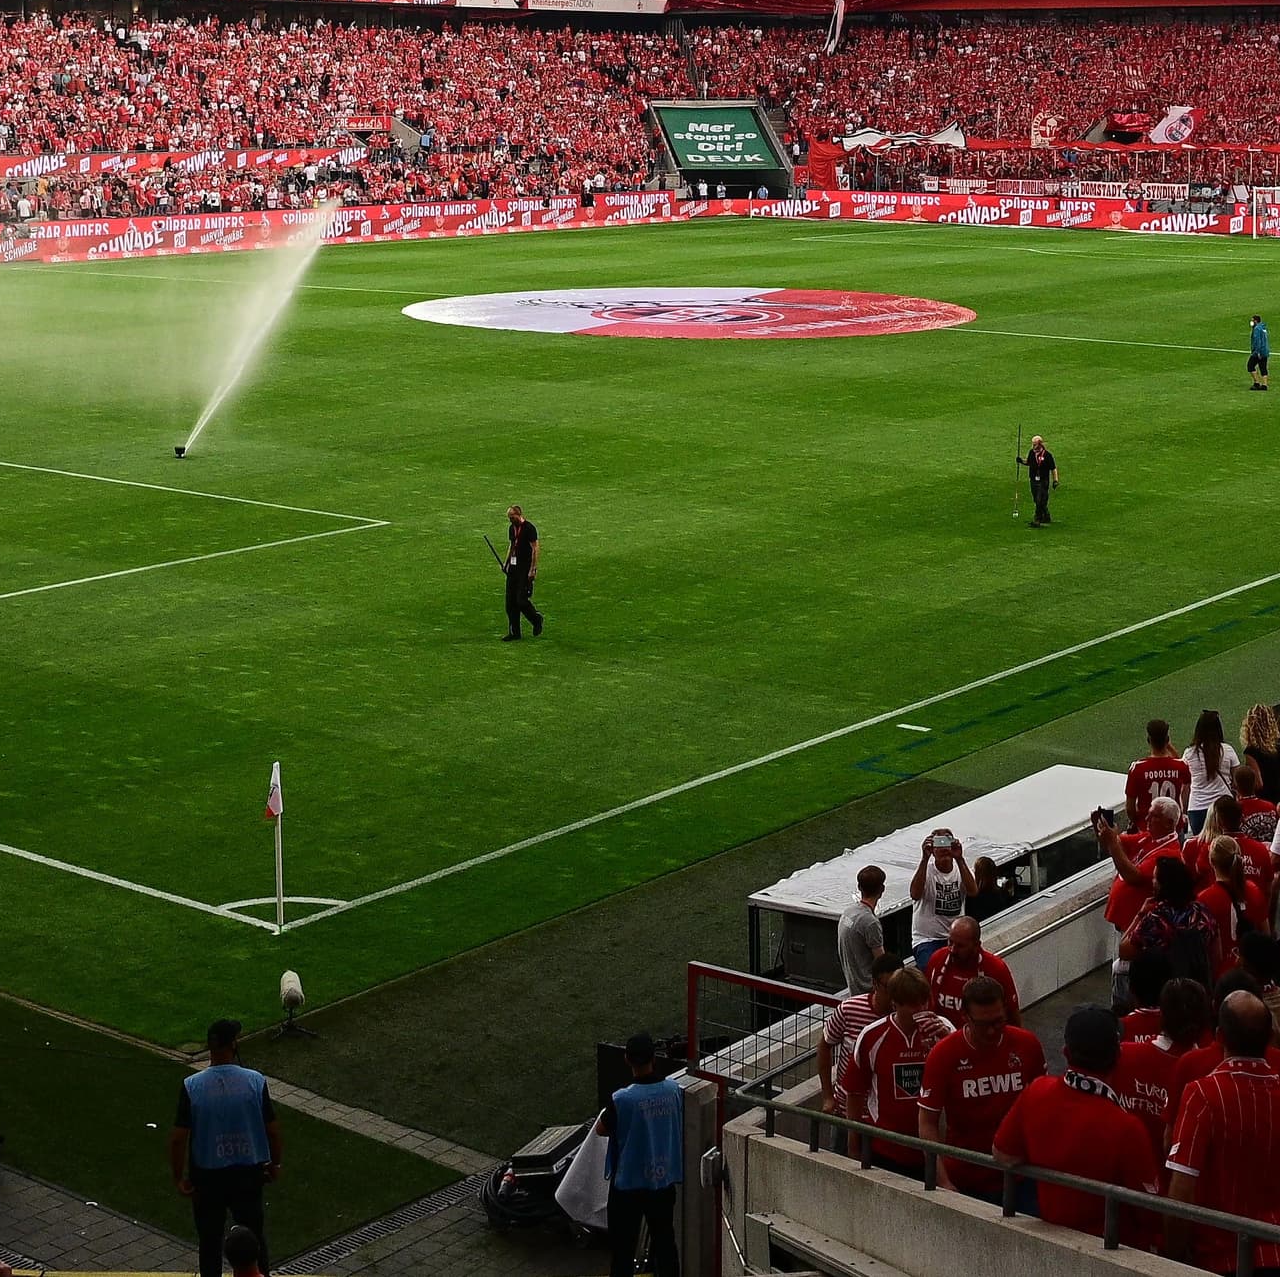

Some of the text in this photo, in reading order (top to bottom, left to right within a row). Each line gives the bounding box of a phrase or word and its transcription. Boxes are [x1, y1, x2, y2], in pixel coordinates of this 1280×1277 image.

[689, 123, 735, 133] Mer
[674, 133, 730, 141] stonn
[698, 142, 743, 151] Dir!
[686, 154, 764, 162] DEVK
[1080, 182, 1121, 197] DOMSTADT
[1146, 185, 1188, 200] SYNDIKAT
[1060, 200, 1095, 212] NDERS
[1046, 209, 1071, 223] MARVIN
[1231, 218, 1242, 232] 20
[1145, 770, 1178, 779] PODOLSKI
[963, 1072, 1023, 1099] REWE
